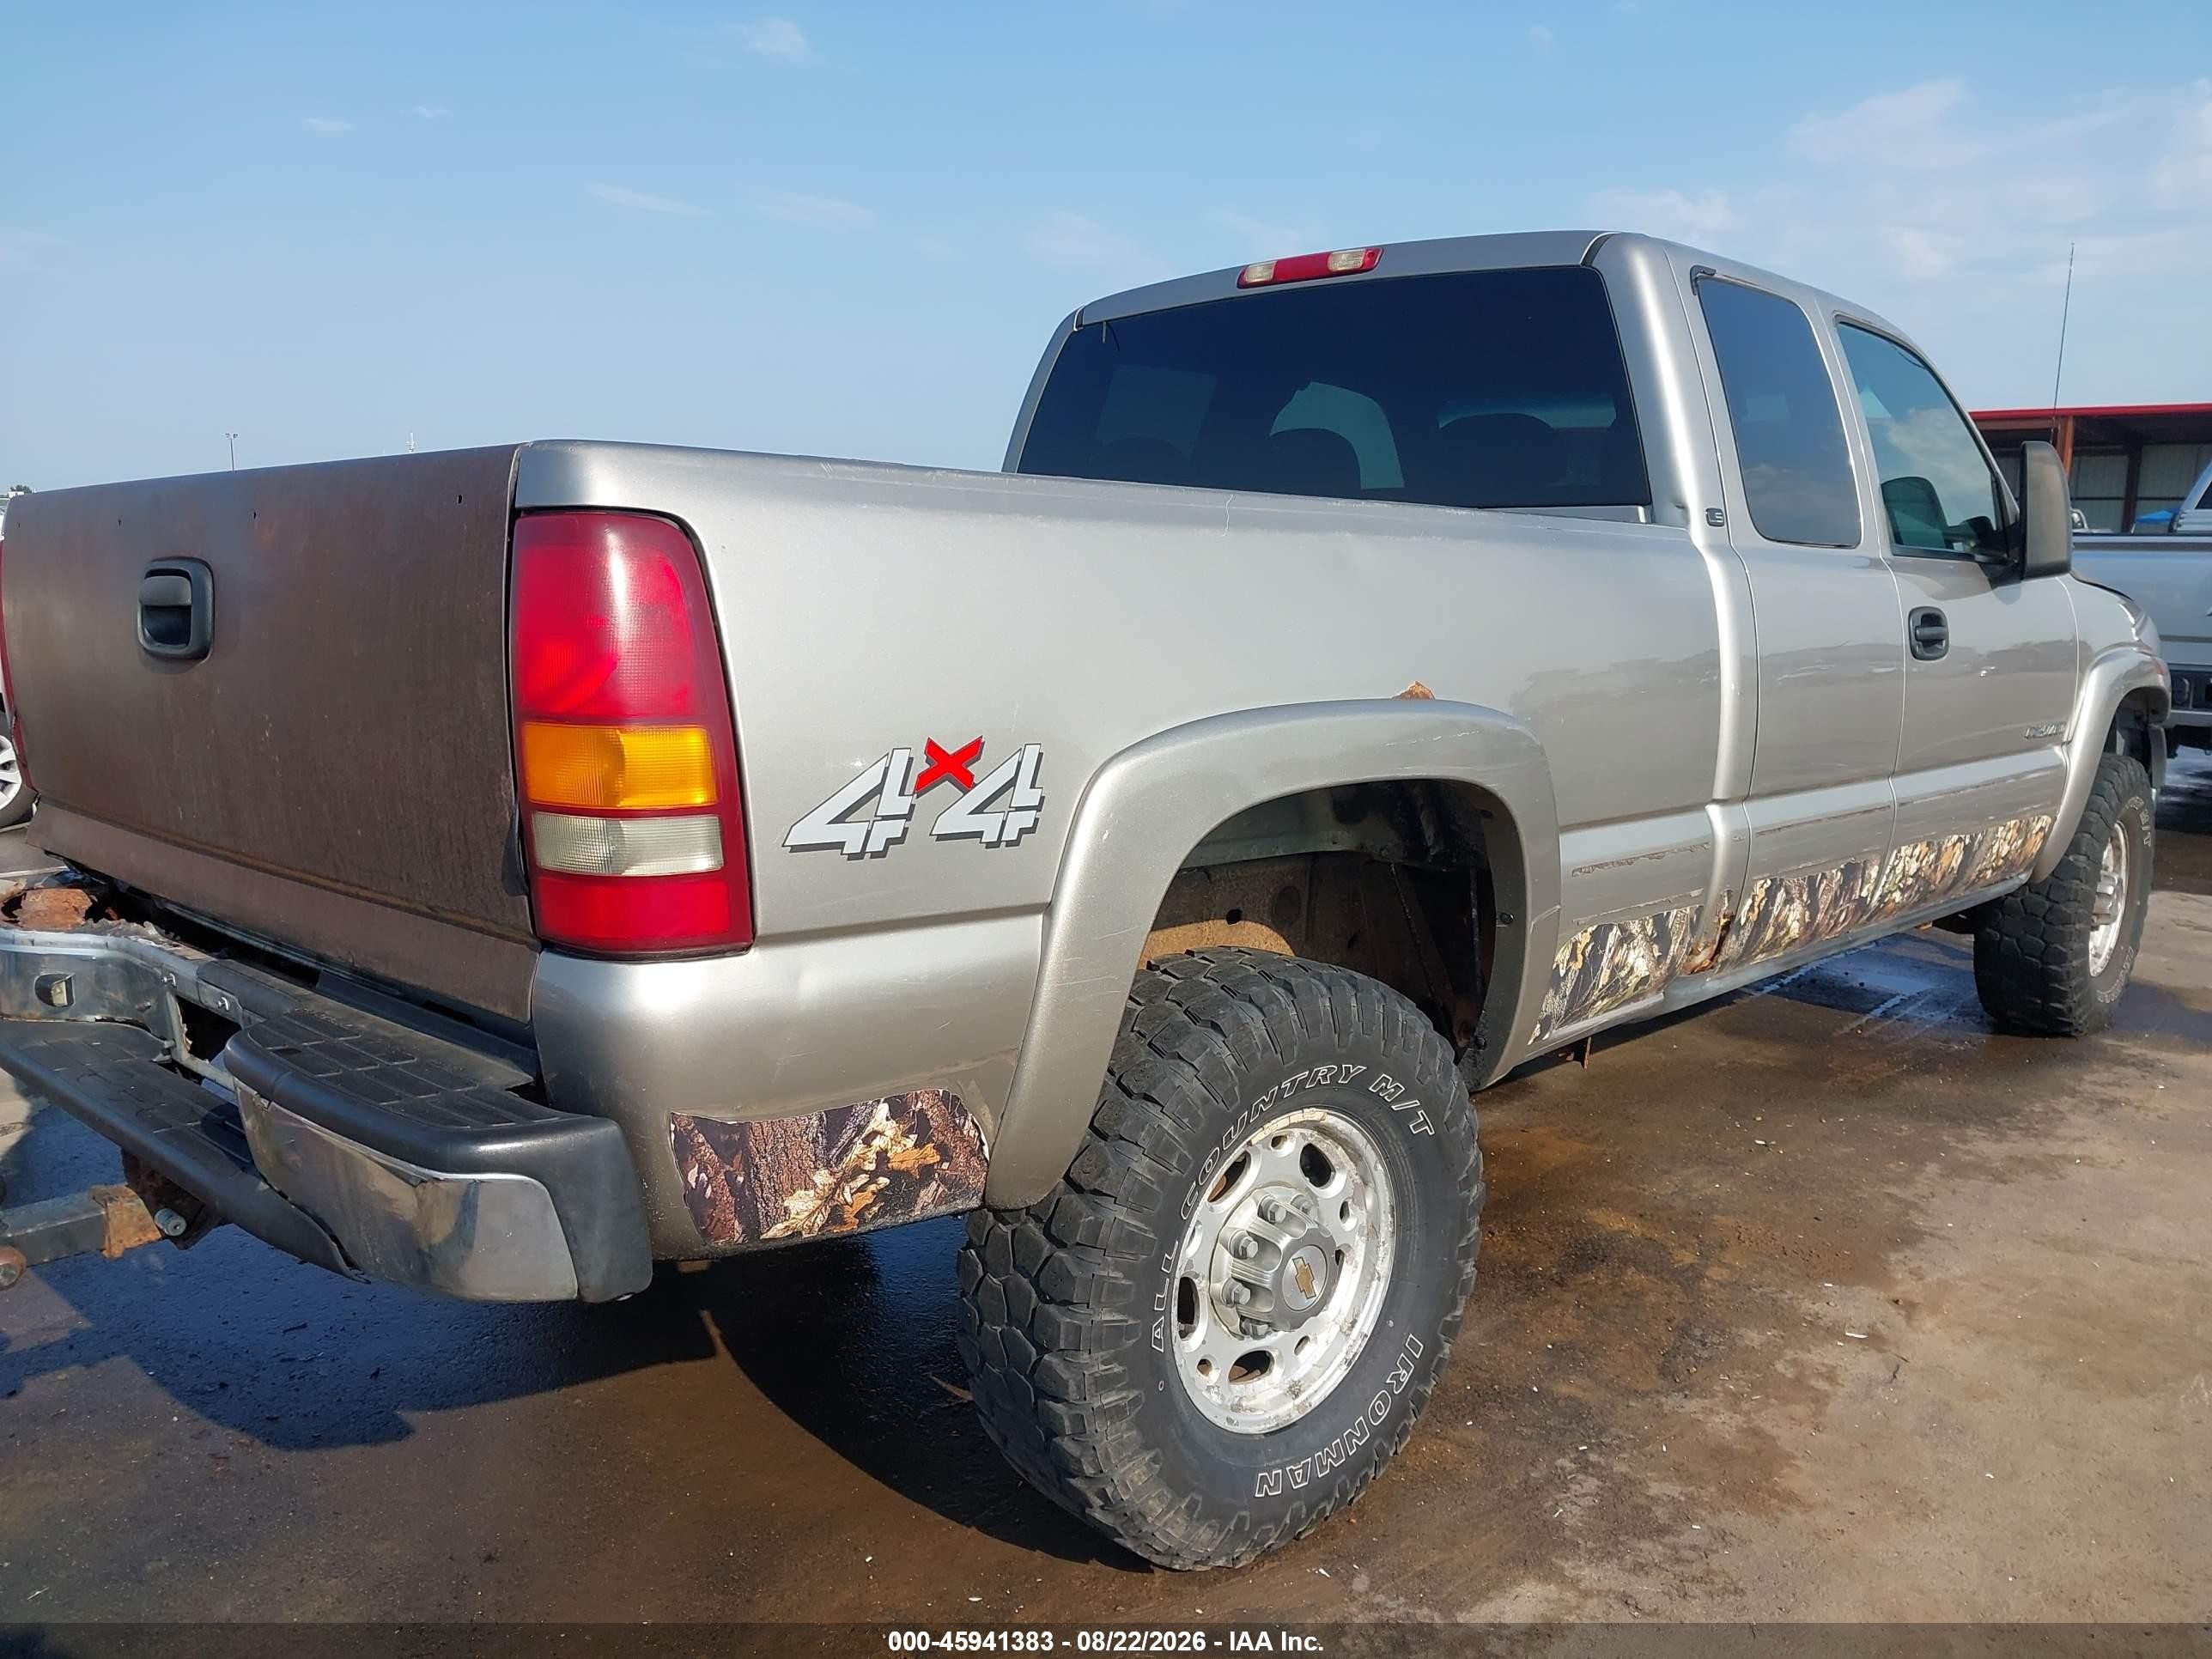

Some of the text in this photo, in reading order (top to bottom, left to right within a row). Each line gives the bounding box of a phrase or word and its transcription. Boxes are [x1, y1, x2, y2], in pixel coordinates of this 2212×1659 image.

[1152, 1064, 1436, 1352] ALL COUNTRY M/T
[1255, 1334, 1424, 1497] IRONMAN
